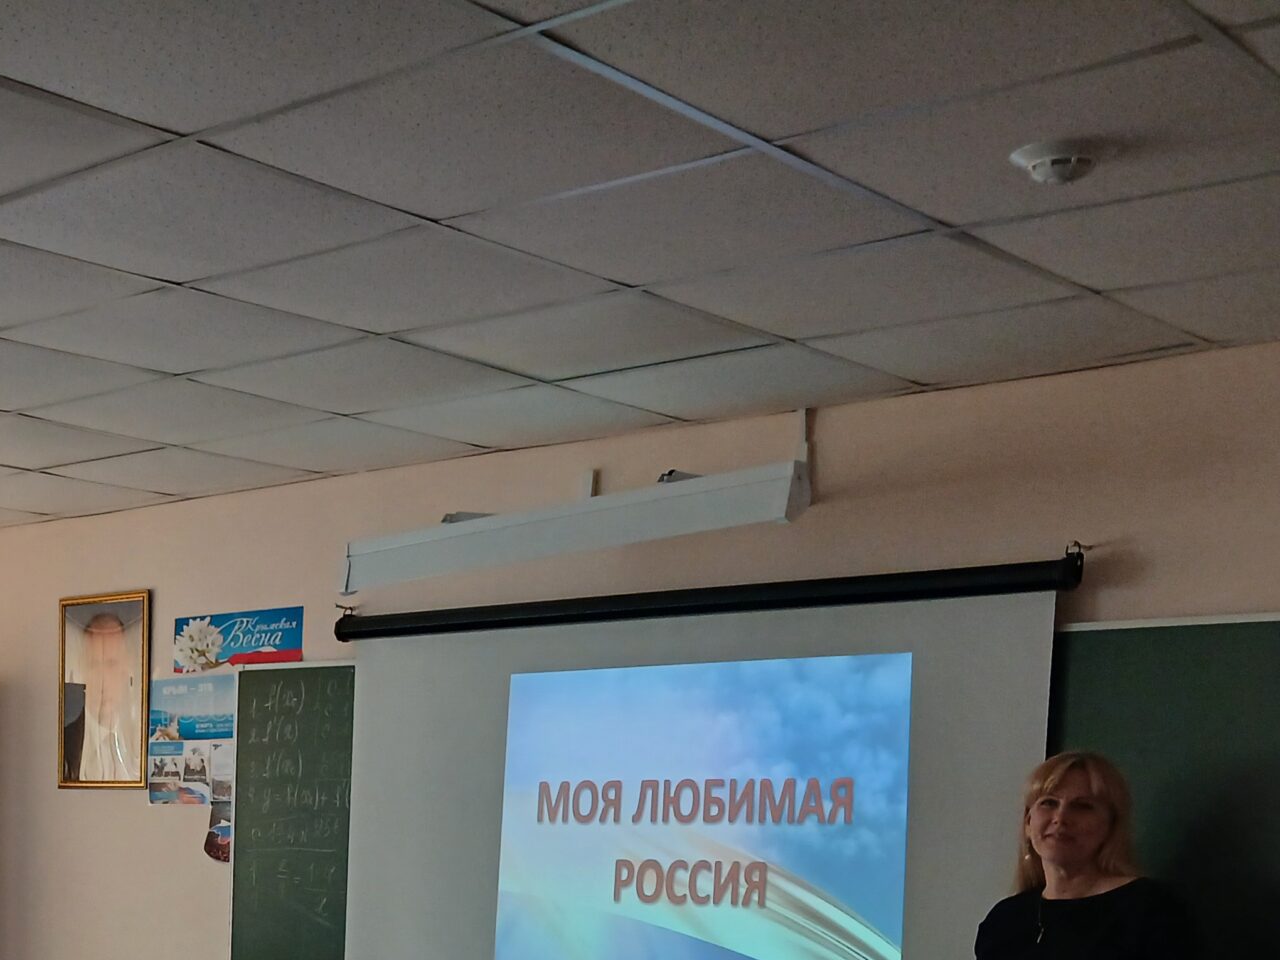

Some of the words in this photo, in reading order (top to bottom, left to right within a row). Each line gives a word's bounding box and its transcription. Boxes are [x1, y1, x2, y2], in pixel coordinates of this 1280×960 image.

[217, 617, 282, 648] Весна
[537, 780, 622, 824] МОЯ
[631, 777, 855, 826] ЛЮБИМАЯ
[613, 859, 768, 908] РОССИЯ
